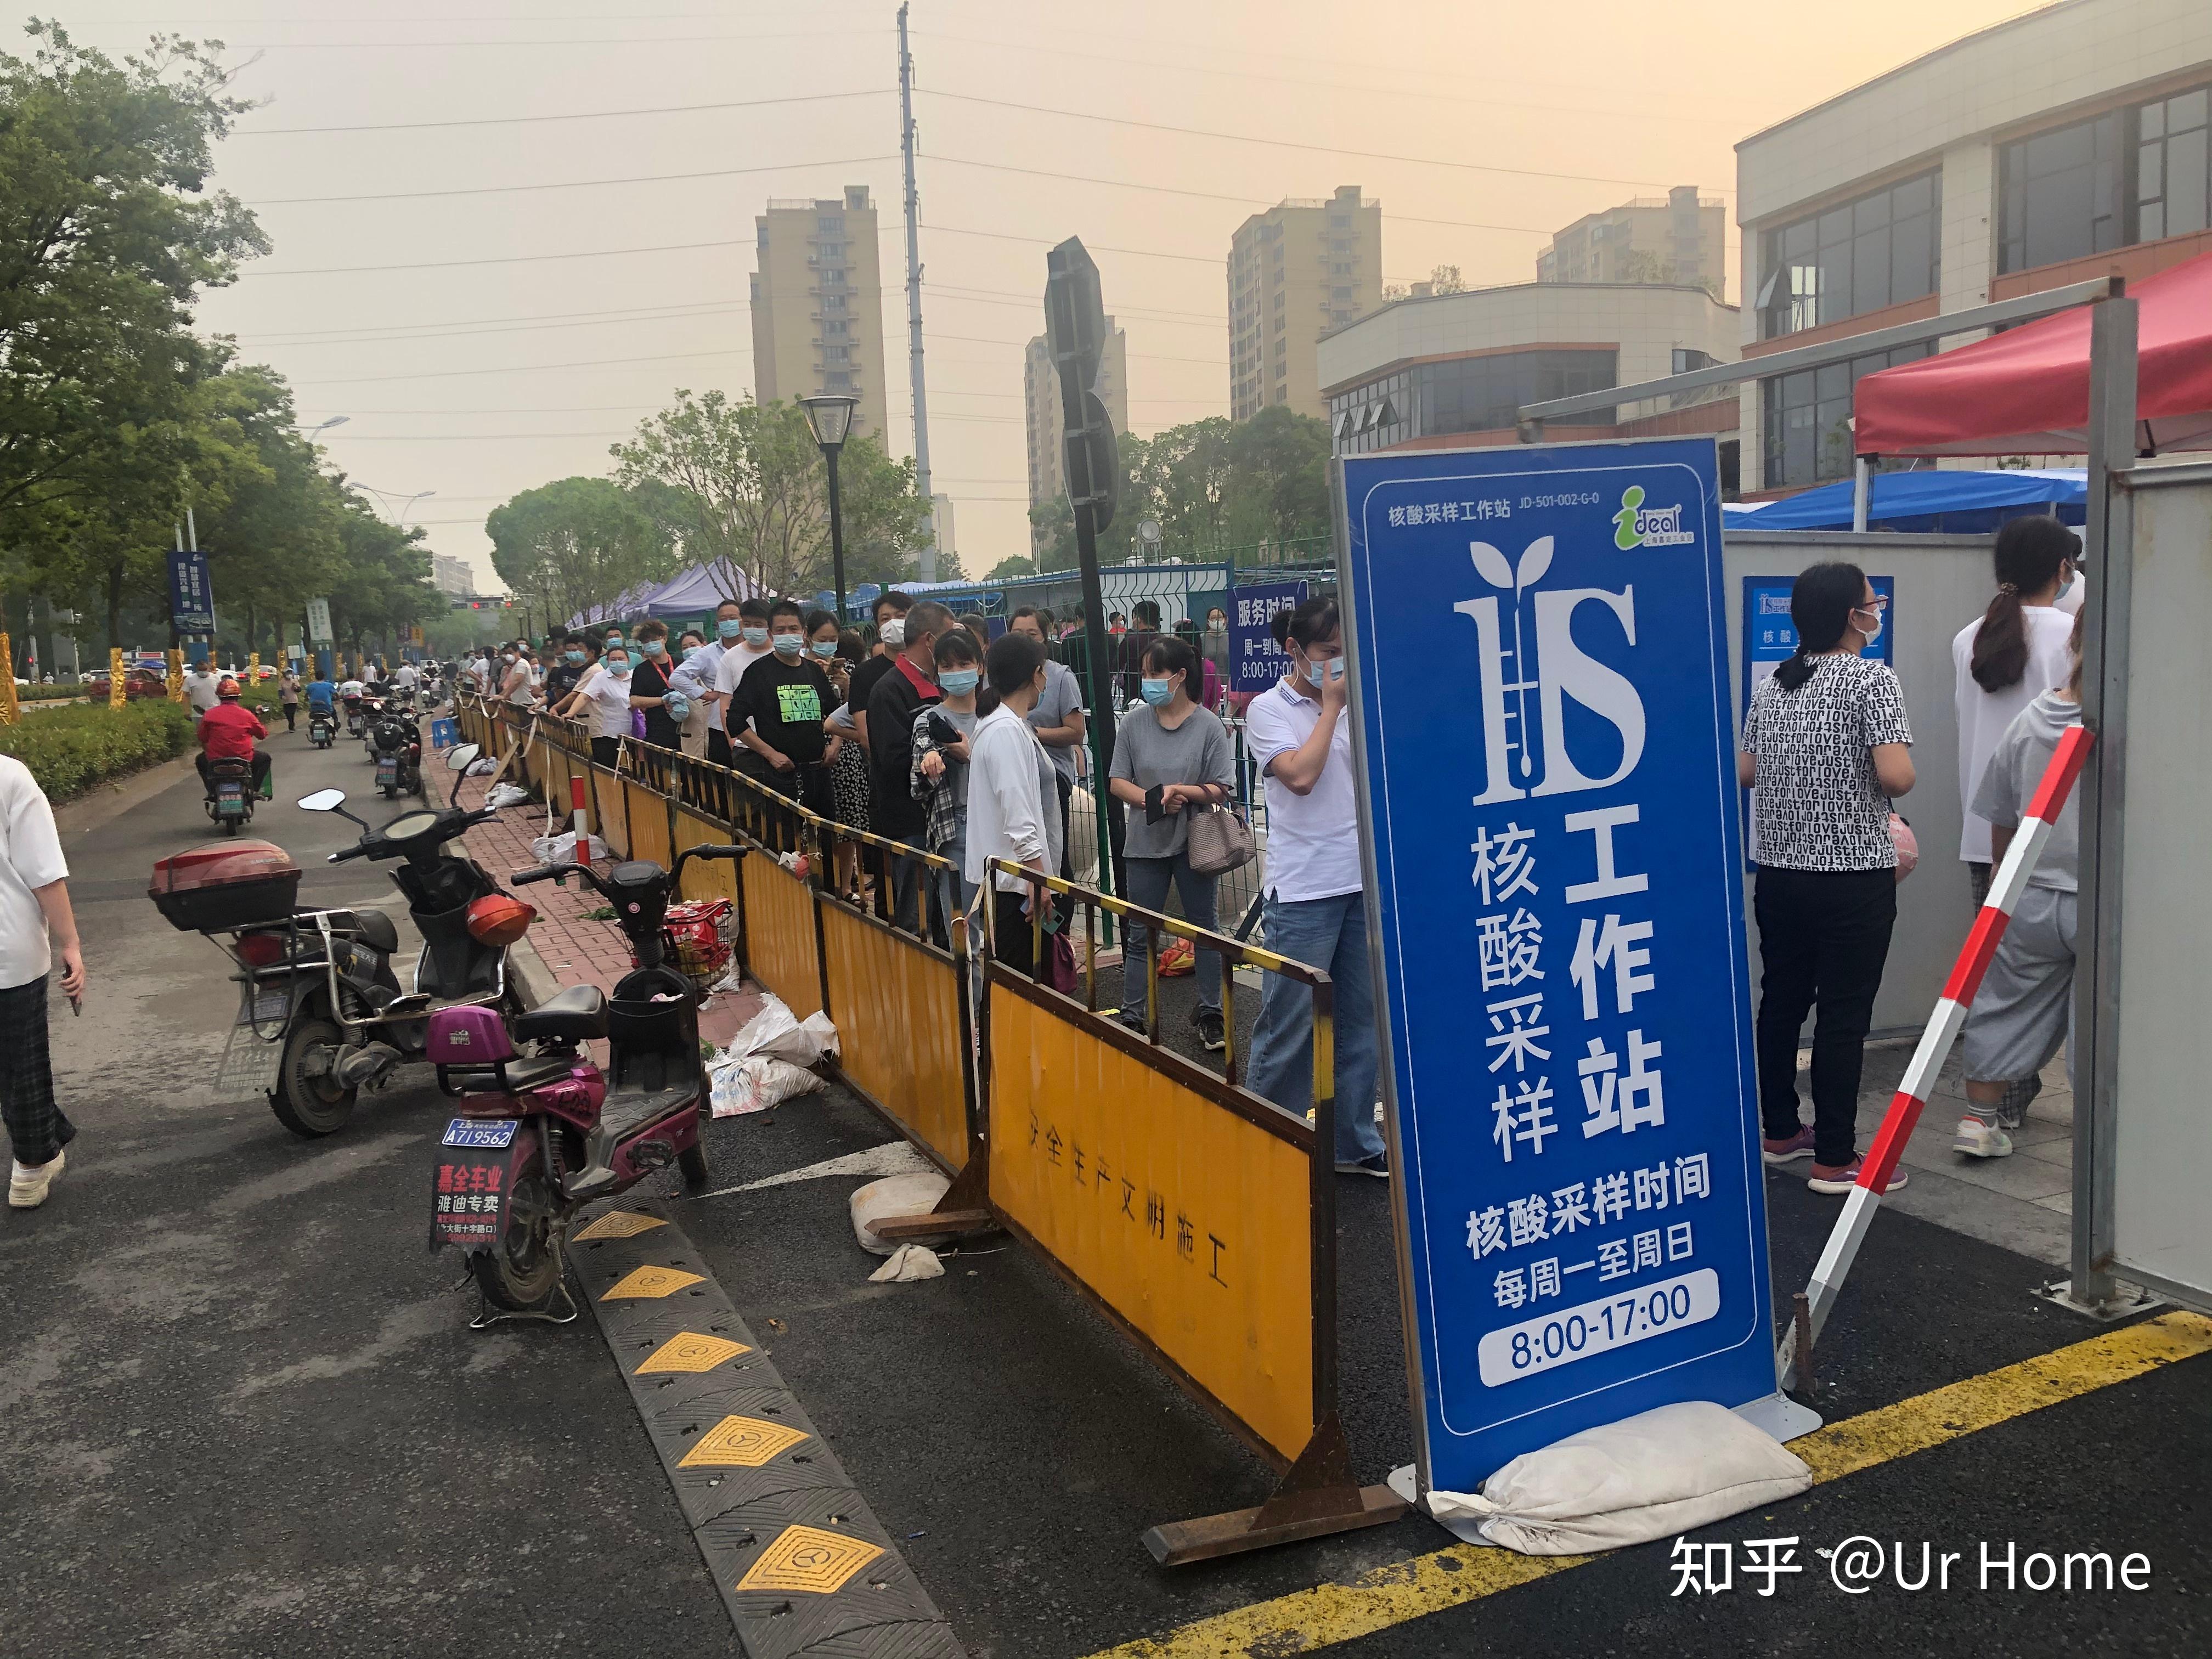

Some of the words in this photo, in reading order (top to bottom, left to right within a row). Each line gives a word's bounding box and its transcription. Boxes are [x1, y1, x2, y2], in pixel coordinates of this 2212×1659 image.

[1388, 498, 1510, 527] 核酸采样工作站
[1519, 492, 1599, 510] JD-501-002-G-0
[1244, 637, 1290, 657] 周一到周
[1471, 822, 1559, 1162] 核酸采样
[1565, 804, 1665, 1139] 工作站
[445, 1130, 511, 1145] A719562
[437, 1195, 499, 1212] 雅迪专卖
[438, 1164, 503, 1193] 嘉全车业
[1466, 1153, 1711, 1260] 核酸采样时间
[1493, 1221, 1694, 1308] 每周一至周日
[1511, 1284, 1691, 1369] 8:00-17:00
